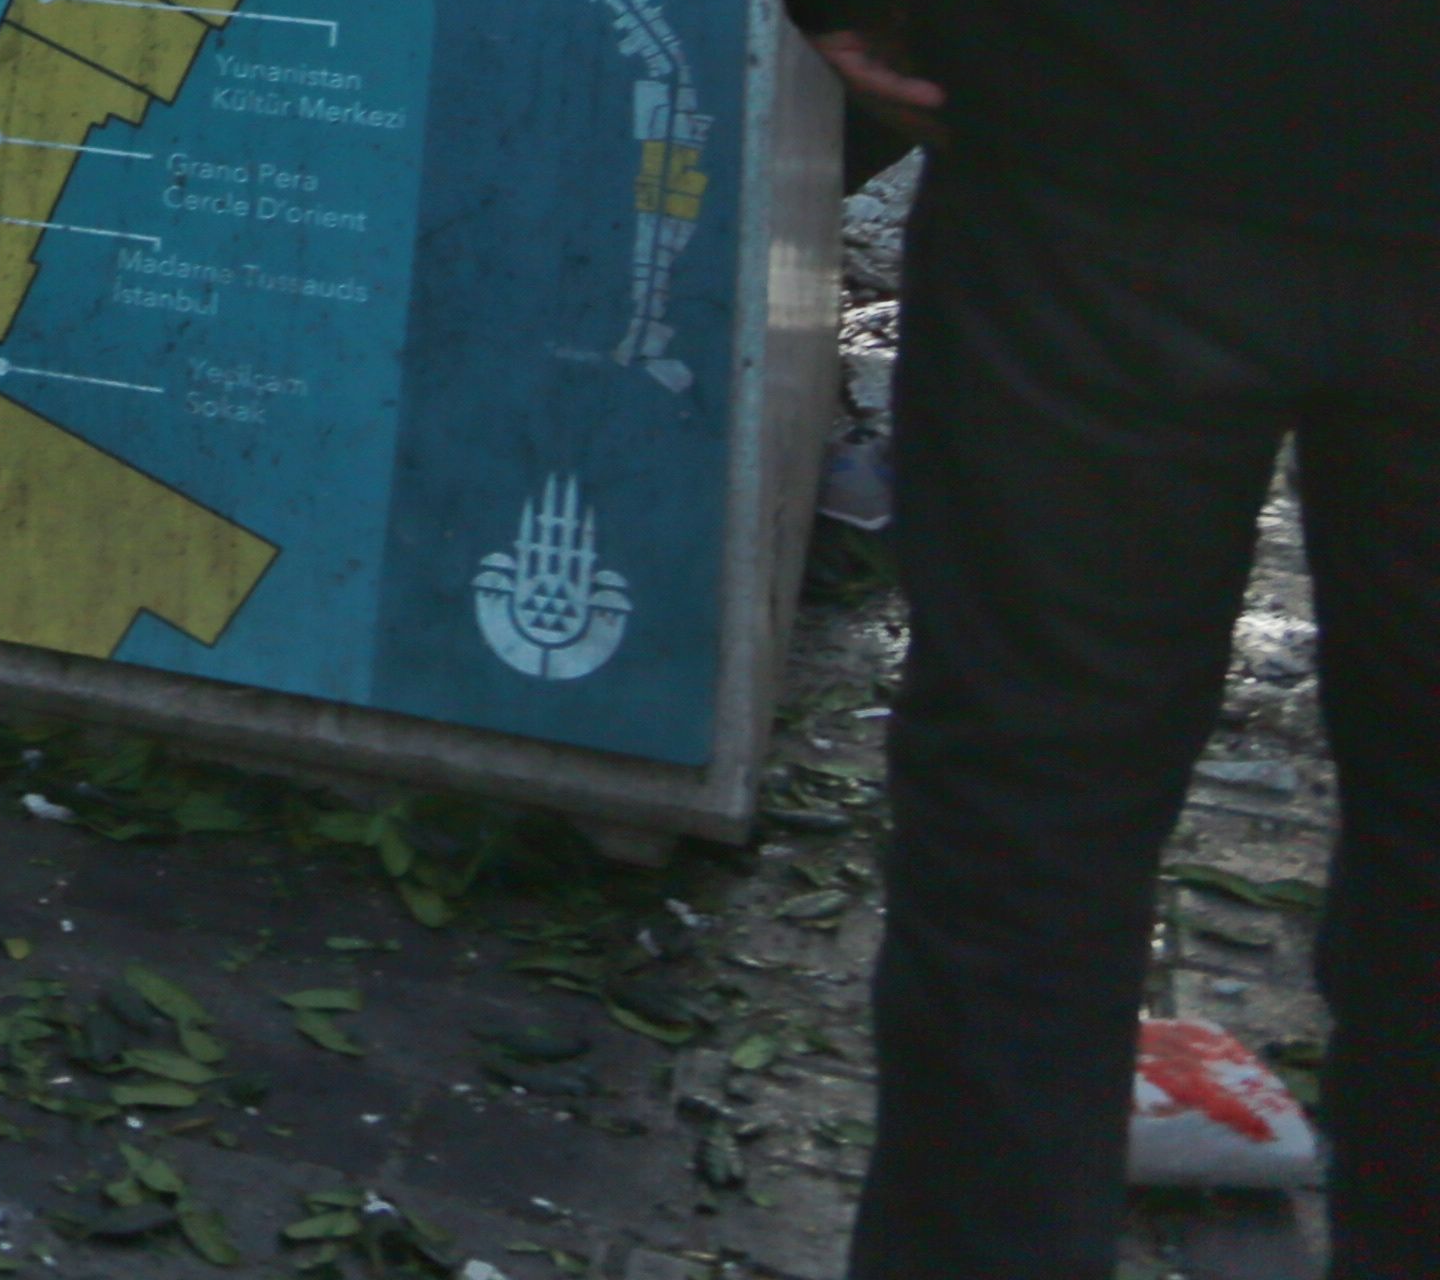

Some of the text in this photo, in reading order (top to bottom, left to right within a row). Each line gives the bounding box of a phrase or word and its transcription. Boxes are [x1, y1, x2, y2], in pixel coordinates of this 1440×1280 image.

[215, 53, 362, 90] Yunanistan
[211, 86, 408, 129] Kültür Merkezi
[257, 162, 319, 192] Pera
[117, 247, 234, 286] Madame
[112, 275, 220, 317] İstanbul
